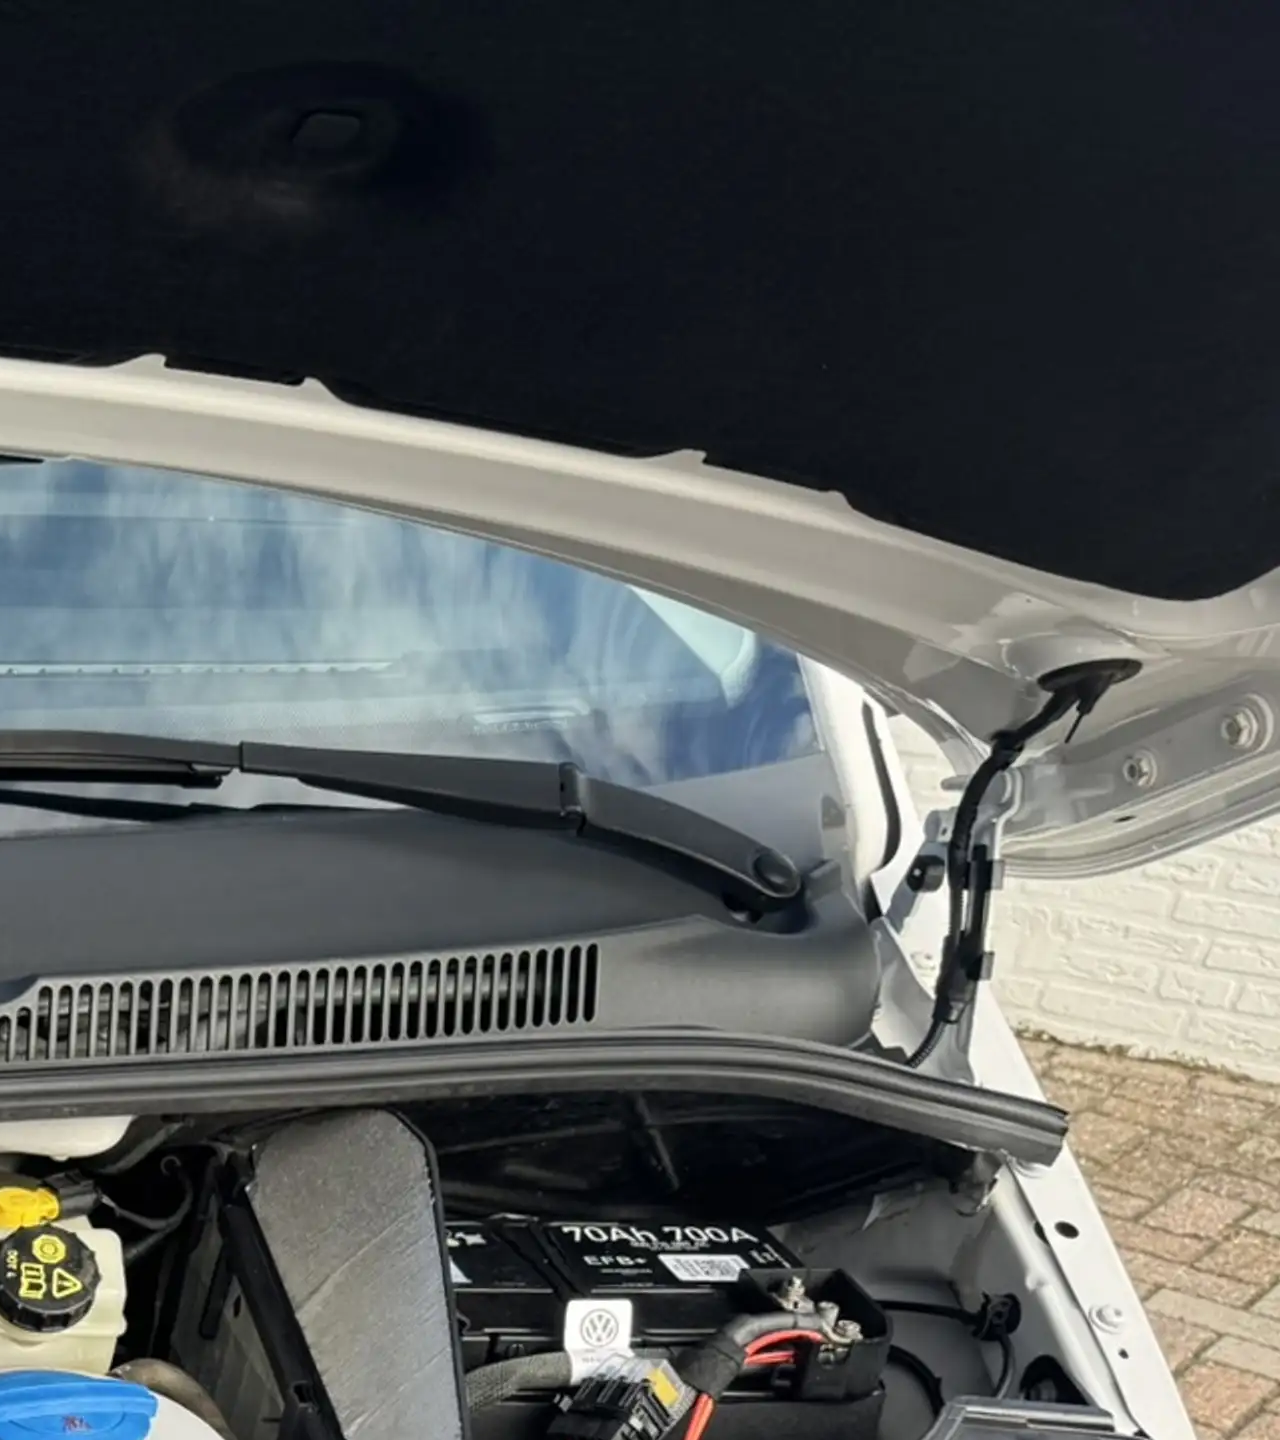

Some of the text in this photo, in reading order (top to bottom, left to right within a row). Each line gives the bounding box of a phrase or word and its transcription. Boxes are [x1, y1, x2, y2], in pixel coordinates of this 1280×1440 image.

[561, 1226, 760, 1244] 70Ah 700A
[583, 1254, 648, 1266] EFB+
